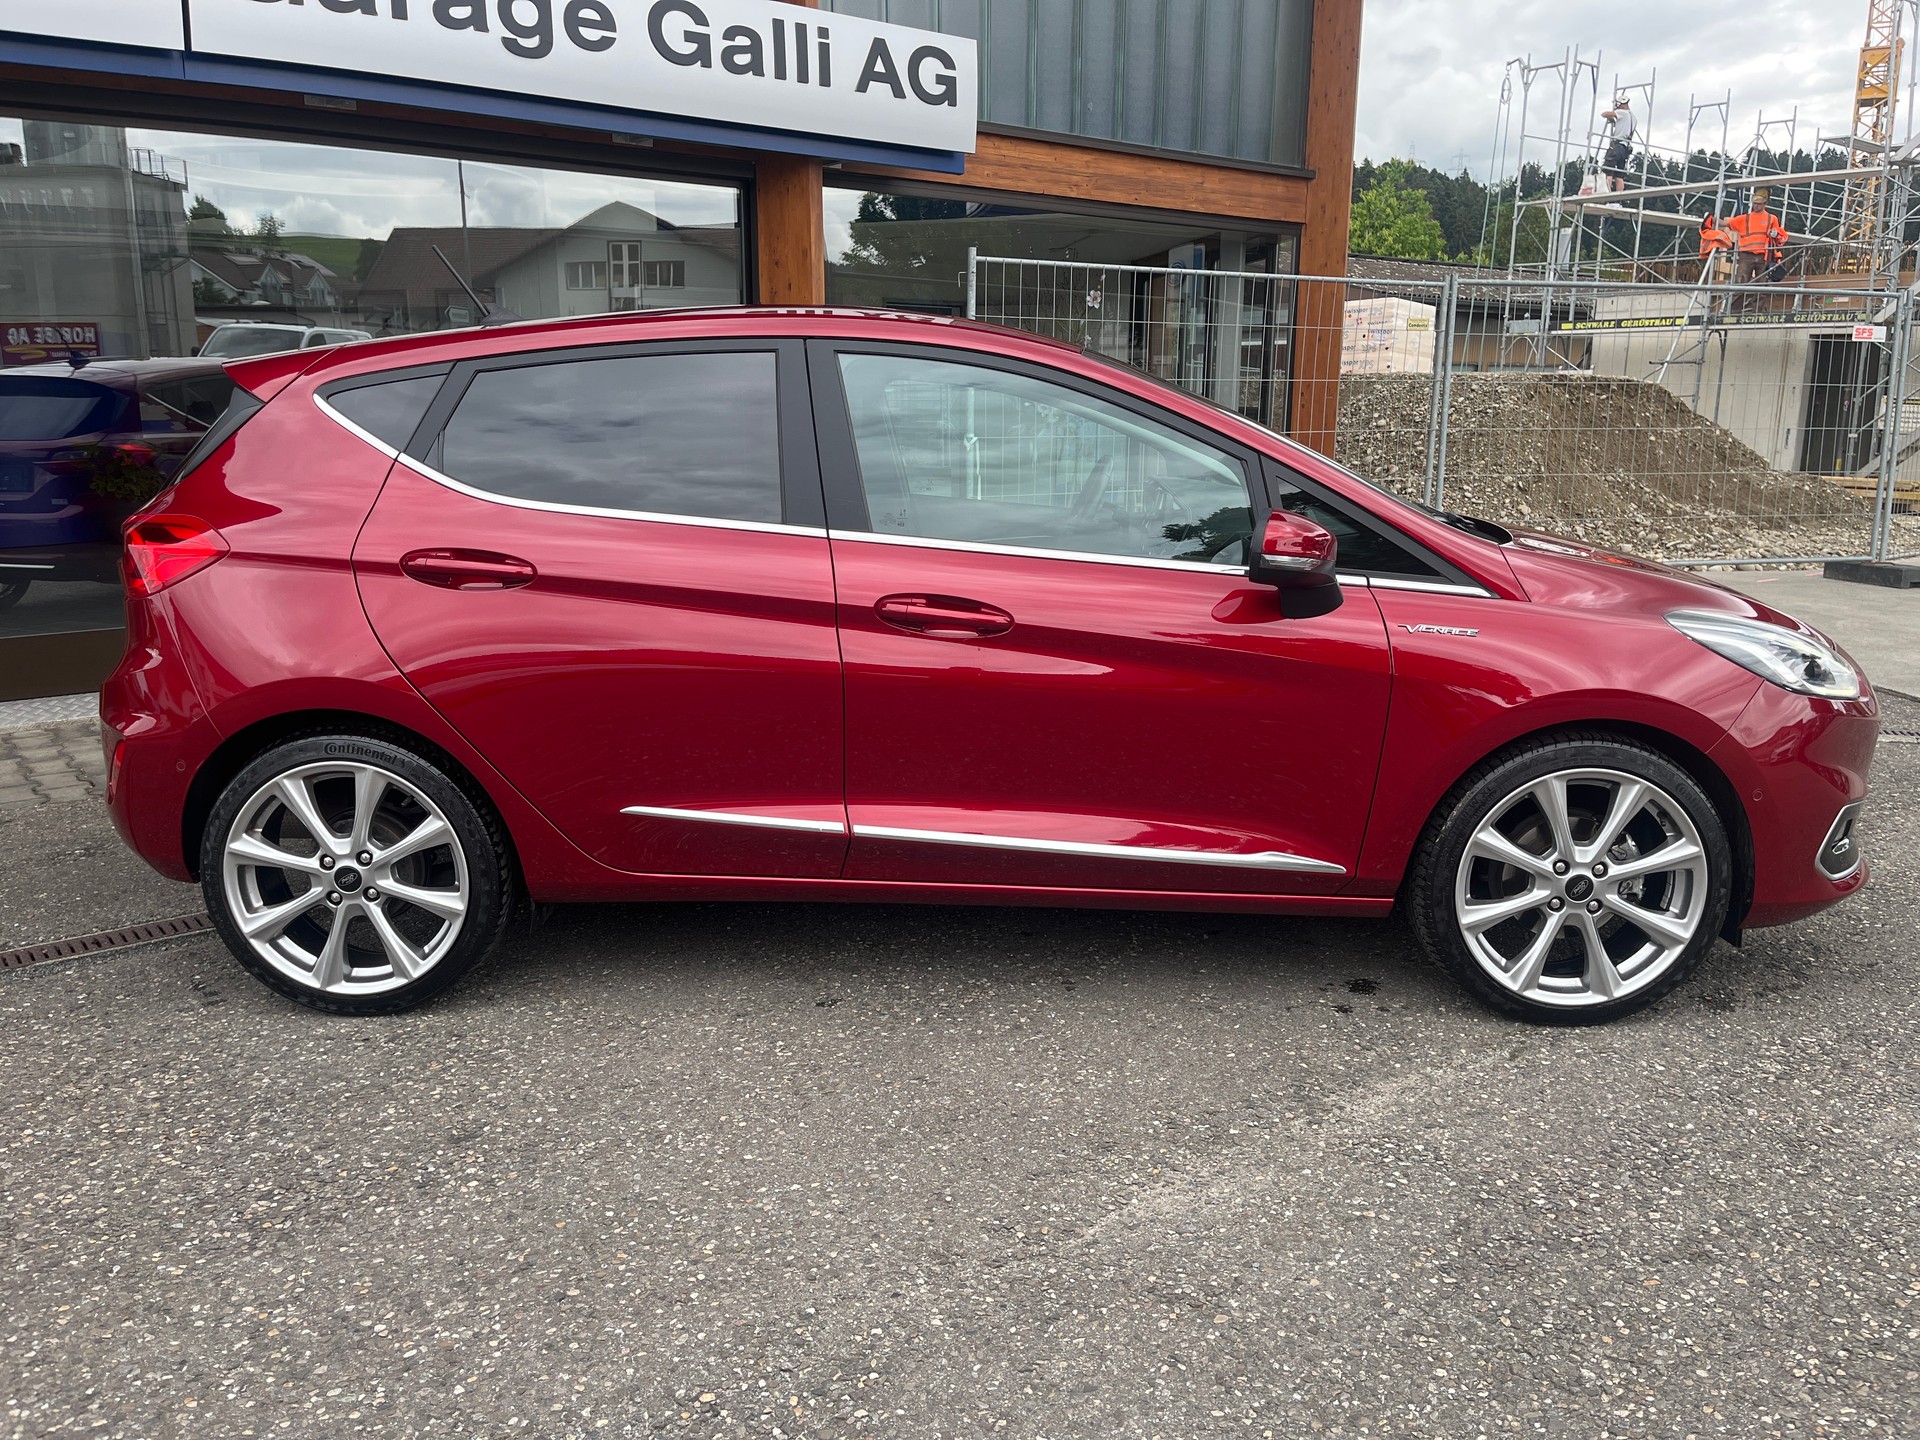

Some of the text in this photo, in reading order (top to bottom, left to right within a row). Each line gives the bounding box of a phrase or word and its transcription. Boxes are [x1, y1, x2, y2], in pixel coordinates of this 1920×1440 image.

[250, 0, 958, 108] age Galli AG
[1739, 314, 1787, 323] SCHWARZ
[1574, 320, 1616, 329] SCHWARZ
[1854, 327, 1873, 337] SFS
[323, 742, 398, 766] Continental
